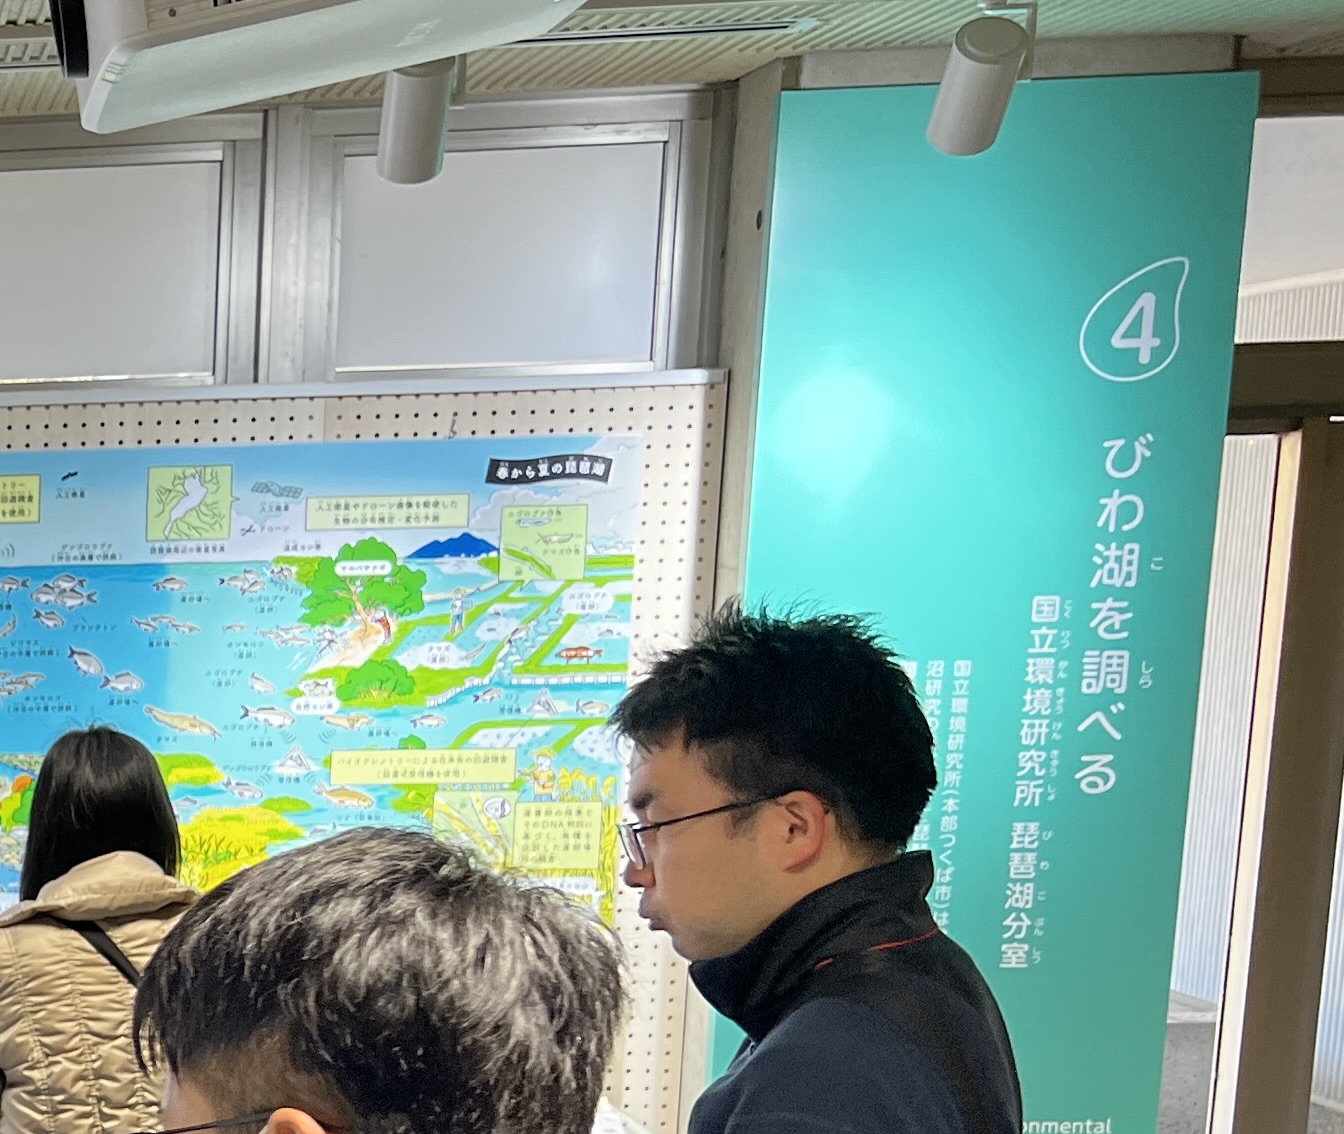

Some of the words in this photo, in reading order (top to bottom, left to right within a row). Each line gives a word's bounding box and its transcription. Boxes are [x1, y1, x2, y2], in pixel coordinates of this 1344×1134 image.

[1111, 291, 1161, 365] 4
[495, 462, 605, 480] 春から夏の琵琶湖
[1074, 432, 1154, 795] びわ湖を調べる
[1013, 595, 1060, 807] 国立環境研究所
[999, 822, 1040, 968] 琵琶湖分室
